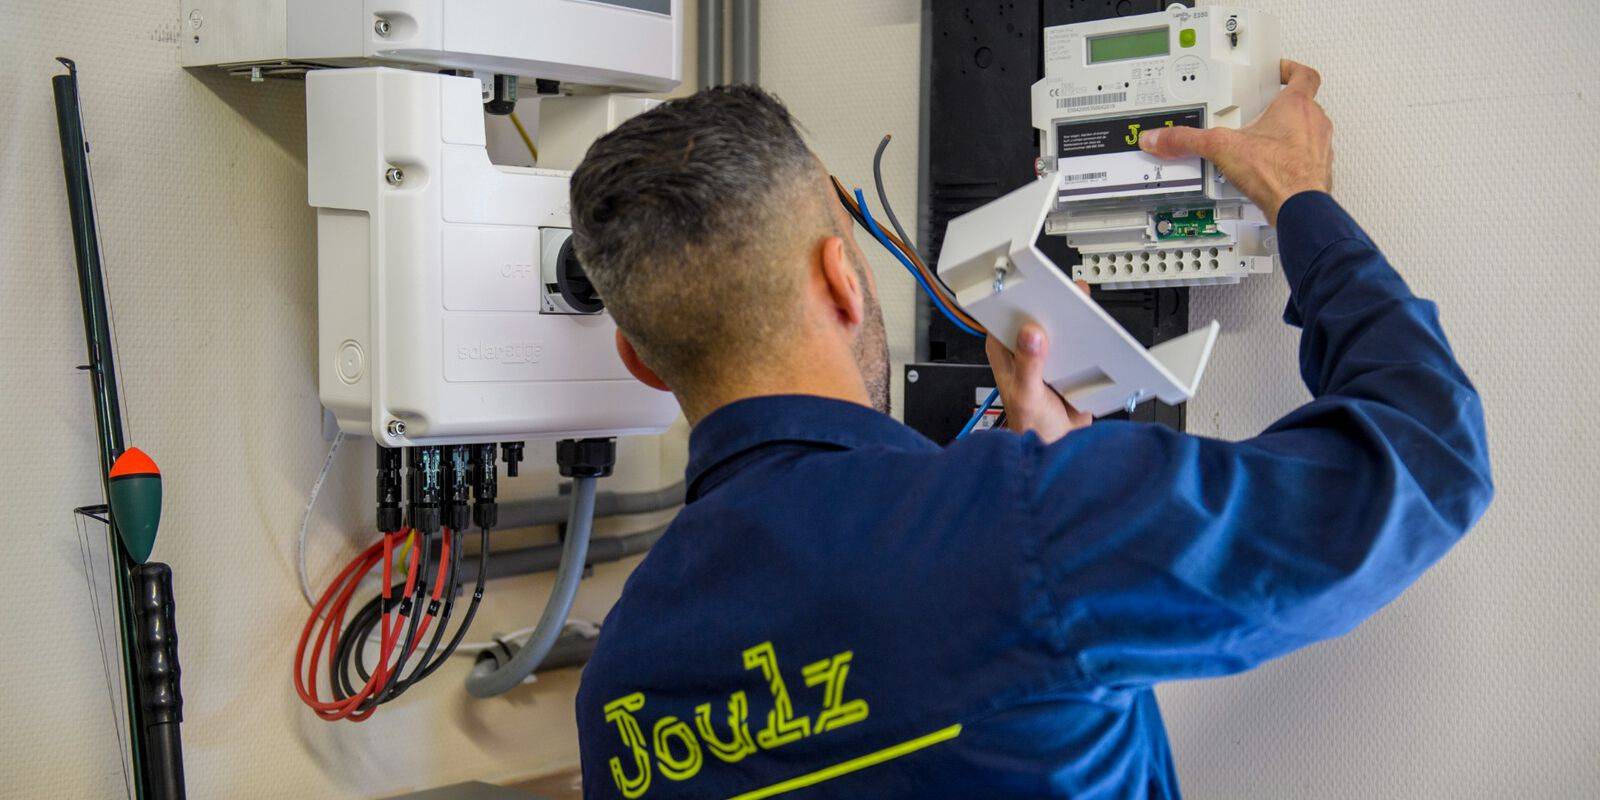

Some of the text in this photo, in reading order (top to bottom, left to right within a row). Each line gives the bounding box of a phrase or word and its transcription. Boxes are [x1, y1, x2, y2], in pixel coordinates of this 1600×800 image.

[500, 263, 532, 279] OFF
[456, 340, 543, 365] solaredge
[604, 640, 869, 799] Joulz
